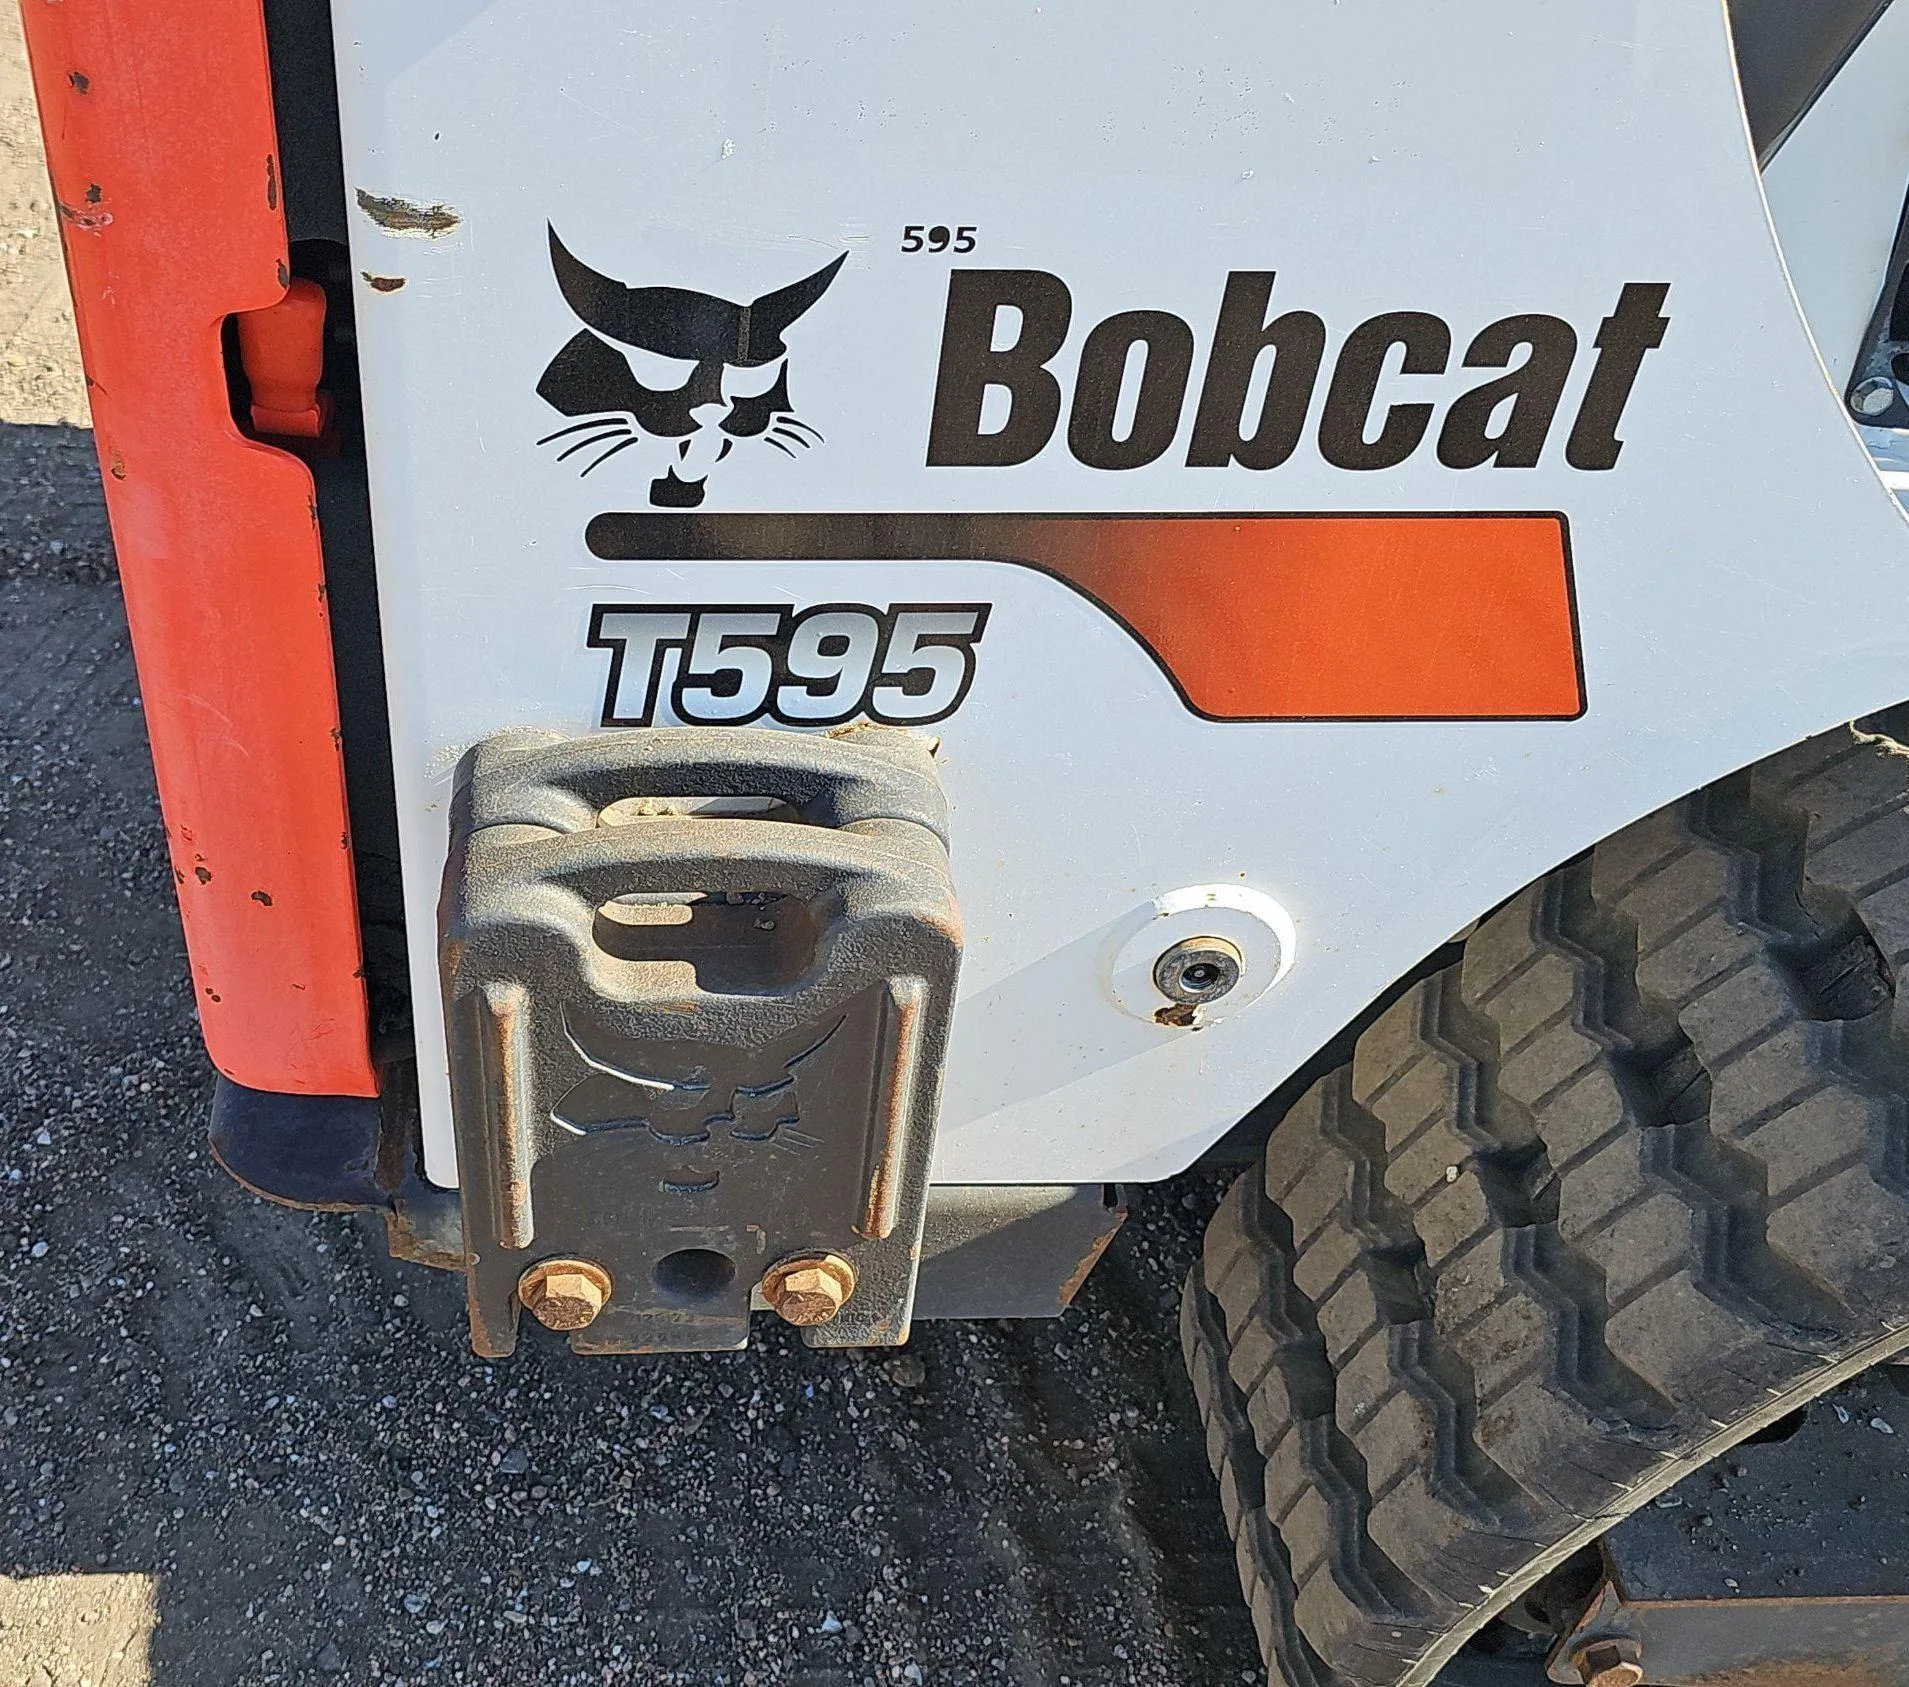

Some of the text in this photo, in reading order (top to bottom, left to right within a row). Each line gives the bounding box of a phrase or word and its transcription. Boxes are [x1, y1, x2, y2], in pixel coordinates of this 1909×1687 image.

[902, 225, 977, 254] 595
[926, 269, 1671, 471] Bobcat
[587, 602, 993, 727] T595
